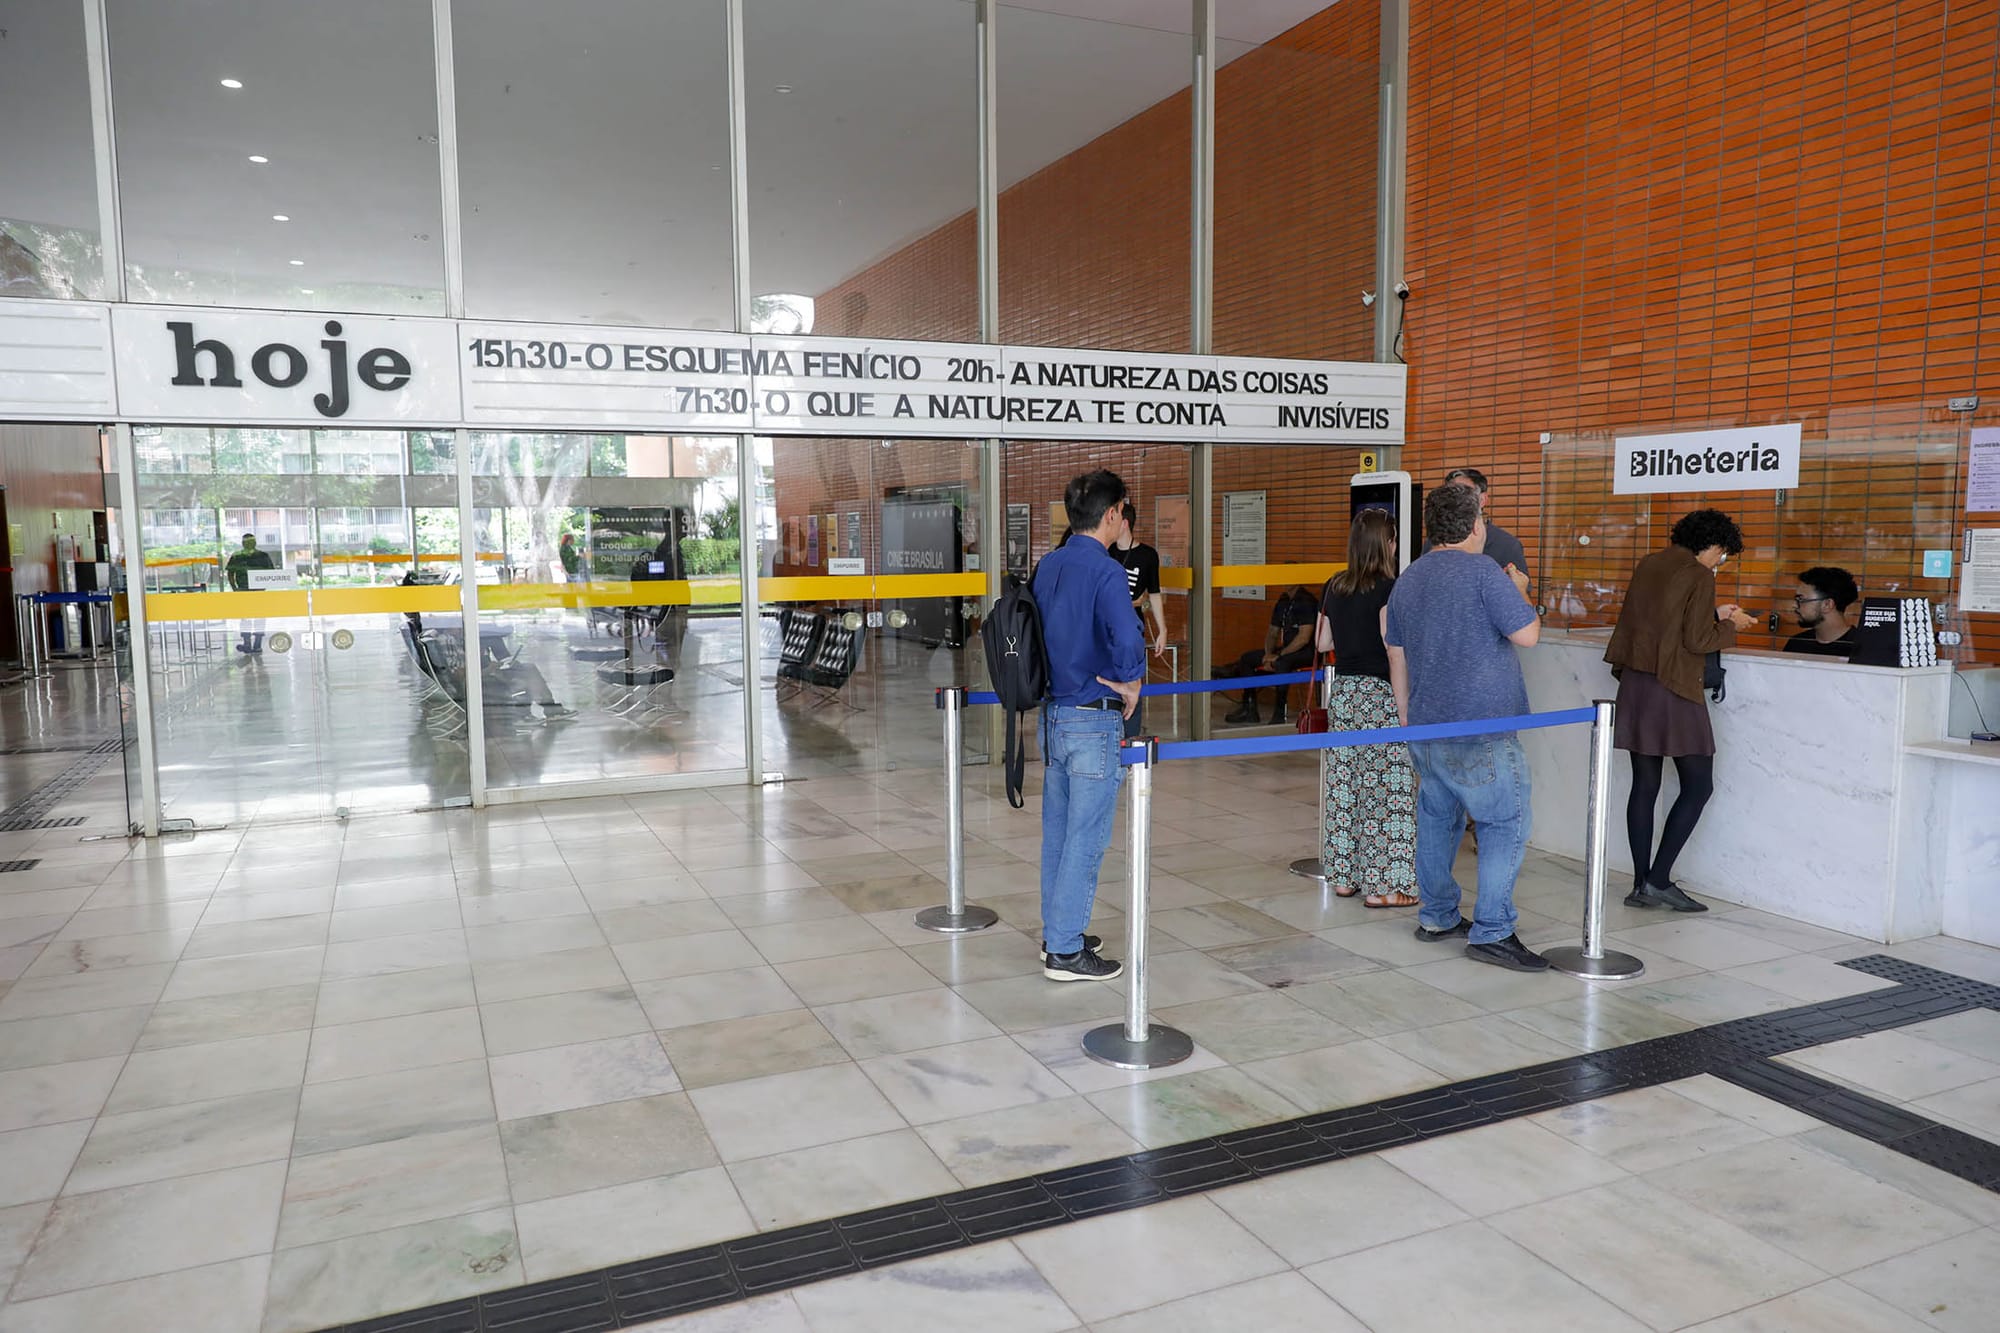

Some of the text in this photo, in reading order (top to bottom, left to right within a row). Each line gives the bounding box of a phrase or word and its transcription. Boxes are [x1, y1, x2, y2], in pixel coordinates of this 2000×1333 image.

[167, 320, 412, 418] hoje
[624, 344, 794, 376] ESQUEMA
[804, 347, 921, 381] FENÍCIO
[1038, 362, 1180, 391] NATUREZA
[1188, 369, 1237, 394] DAS
[1243, 371, 1329, 395] COISAS
[807, 391, 875, 417] QUE
[893, 394, 915, 418] A
[928, 394, 1083, 422] NATUREZA
[1092, 401, 1125, 424] TE
[1136, 402, 1226, 427] CONTA
[1278, 402, 1389, 430] INVISÍVEIS
[1630, 442, 1780, 477] Bilheteria
[910, 548, 945, 570] BRASÍLIA
